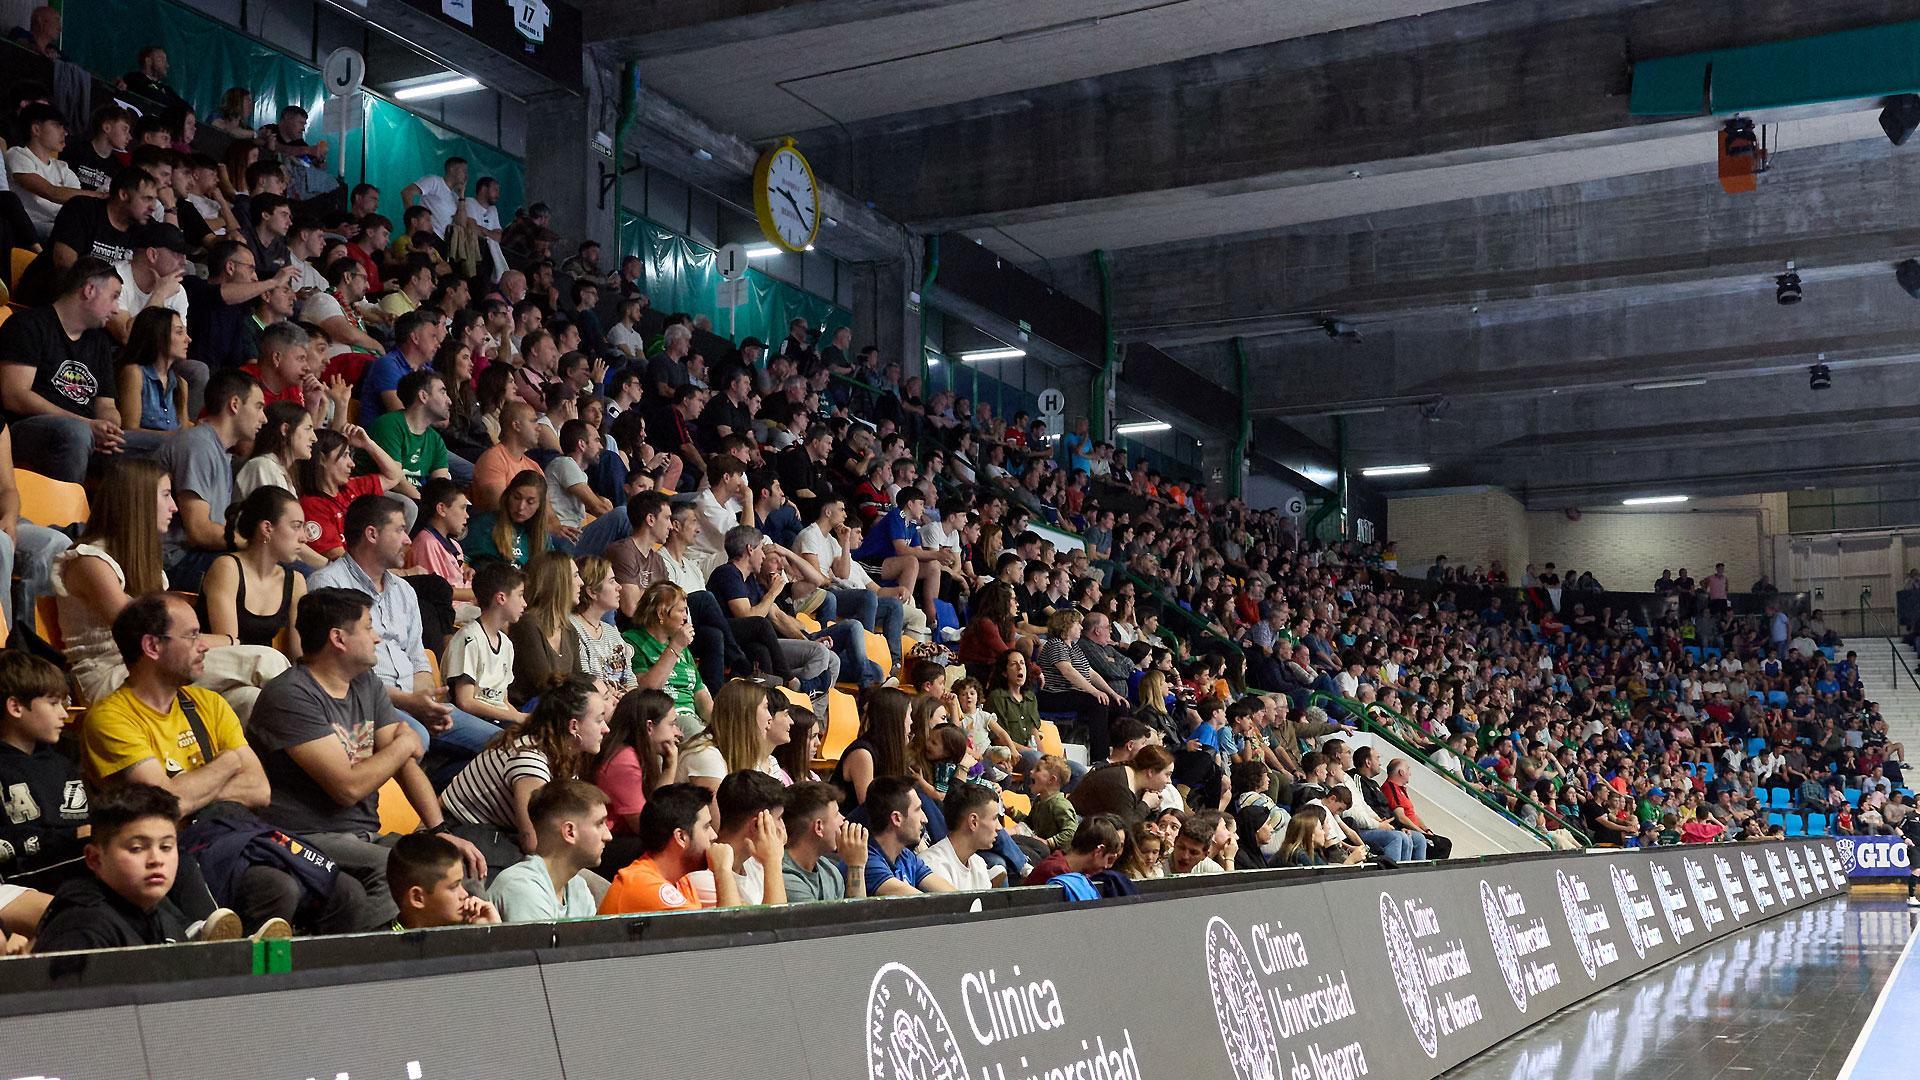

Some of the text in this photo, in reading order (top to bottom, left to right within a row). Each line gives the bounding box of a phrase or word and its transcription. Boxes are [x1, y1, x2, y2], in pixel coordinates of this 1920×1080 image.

[523, 5, 536, 24] 17
[336, 57, 352, 86] J
[1046, 395, 1057, 414] H
[1290, 500, 1302, 514] G
[1252, 921, 1309, 975] Clínica
[961, 965, 1065, 1045] Clínica
[1268, 970, 1356, 1038] Universidad
[1308, 1042, 1368, 1080] Navarra
